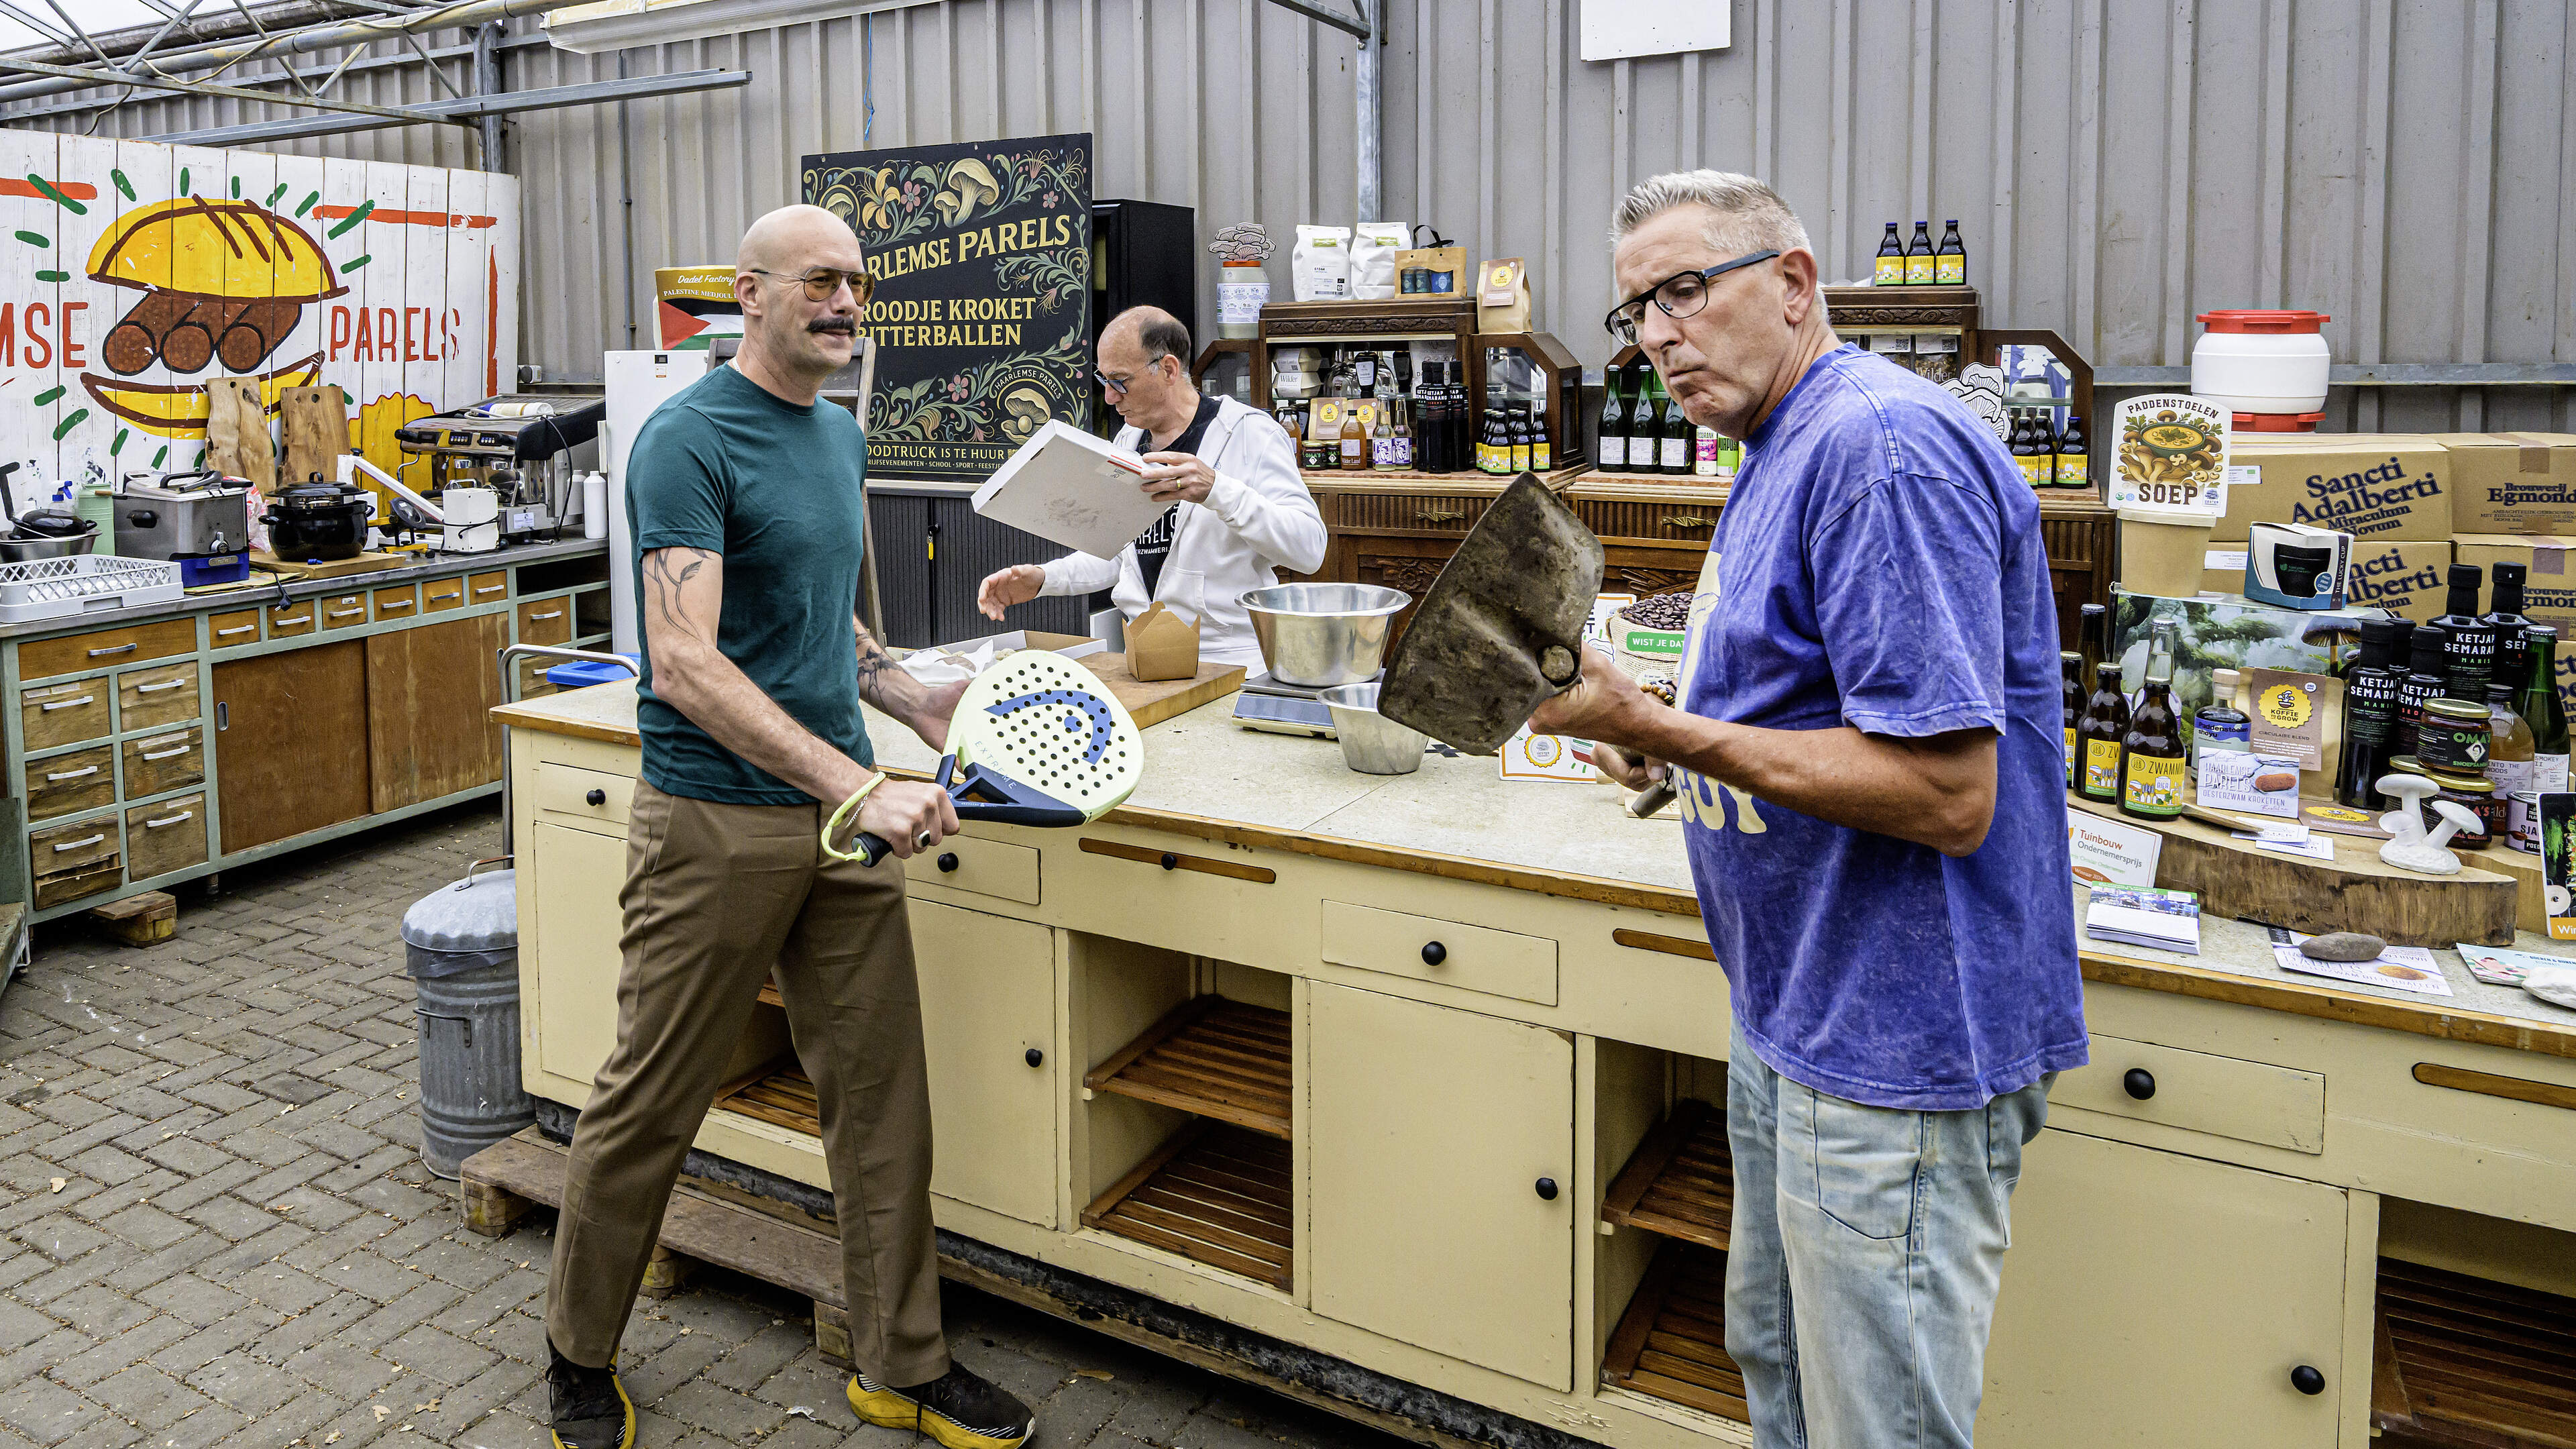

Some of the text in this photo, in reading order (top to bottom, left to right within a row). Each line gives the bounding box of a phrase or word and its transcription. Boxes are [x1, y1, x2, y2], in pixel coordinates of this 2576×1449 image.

[867, 215, 1070, 282] RLEMSE PARELS
[678, 274, 735, 286] Dadel Factory
[700, 290, 733, 299] MEDJOUL
[860, 297, 1036, 322] ROODJE KROKET
[329, 305, 460, 362] PARELS
[1917, 367, 1951, 382] Wilder
[995, 370, 1062, 399] HAARLEMSE PARELS
[2127, 398, 2219, 419] PADDENSTOELEN
[867, 445, 1004, 460] OODTRUCK IS TE HUUR
[2306, 456, 2407, 498] Sancti
[2139, 482, 2198, 505] SOEP
[2504, 483, 2567, 494] Brouwerij
[2292, 472, 2443, 523] Adalberti
[2326, 505, 2412, 530] Miraculum
[2342, 519, 2404, 536] Novum
[2351, 548, 2408, 579] ncti
[2349, 564, 2443, 604] lberti
[1632, 638, 1654, 646] WIST
[2445, 643, 2495, 655] SEMARA
[2359, 676, 2397, 688] KETJA
[2351, 686, 2396, 699] SEMARA
[2402, 684, 2445, 698] KETJAP
[2271, 709, 2299, 717] KOFFIE
[2402, 708, 2425, 716] SED
[2198, 730, 2218, 738] shoyu
[2259, 731, 2290, 739] CIRCULAIRE
[975, 741, 1017, 790] EXTREME
[2205, 763, 2251, 775] HAARLEMSE
[2204, 773, 2251, 793] PARELS
[2203, 789, 2285, 806] OESTERZWAM KROKETTEN
[2473, 806, 2489, 816] A'S
[2520, 825, 2537, 836] SJA
[2080, 829, 2123, 850] Tuinbouw
[2078, 841, 2142, 868] Ondernemersprijs
